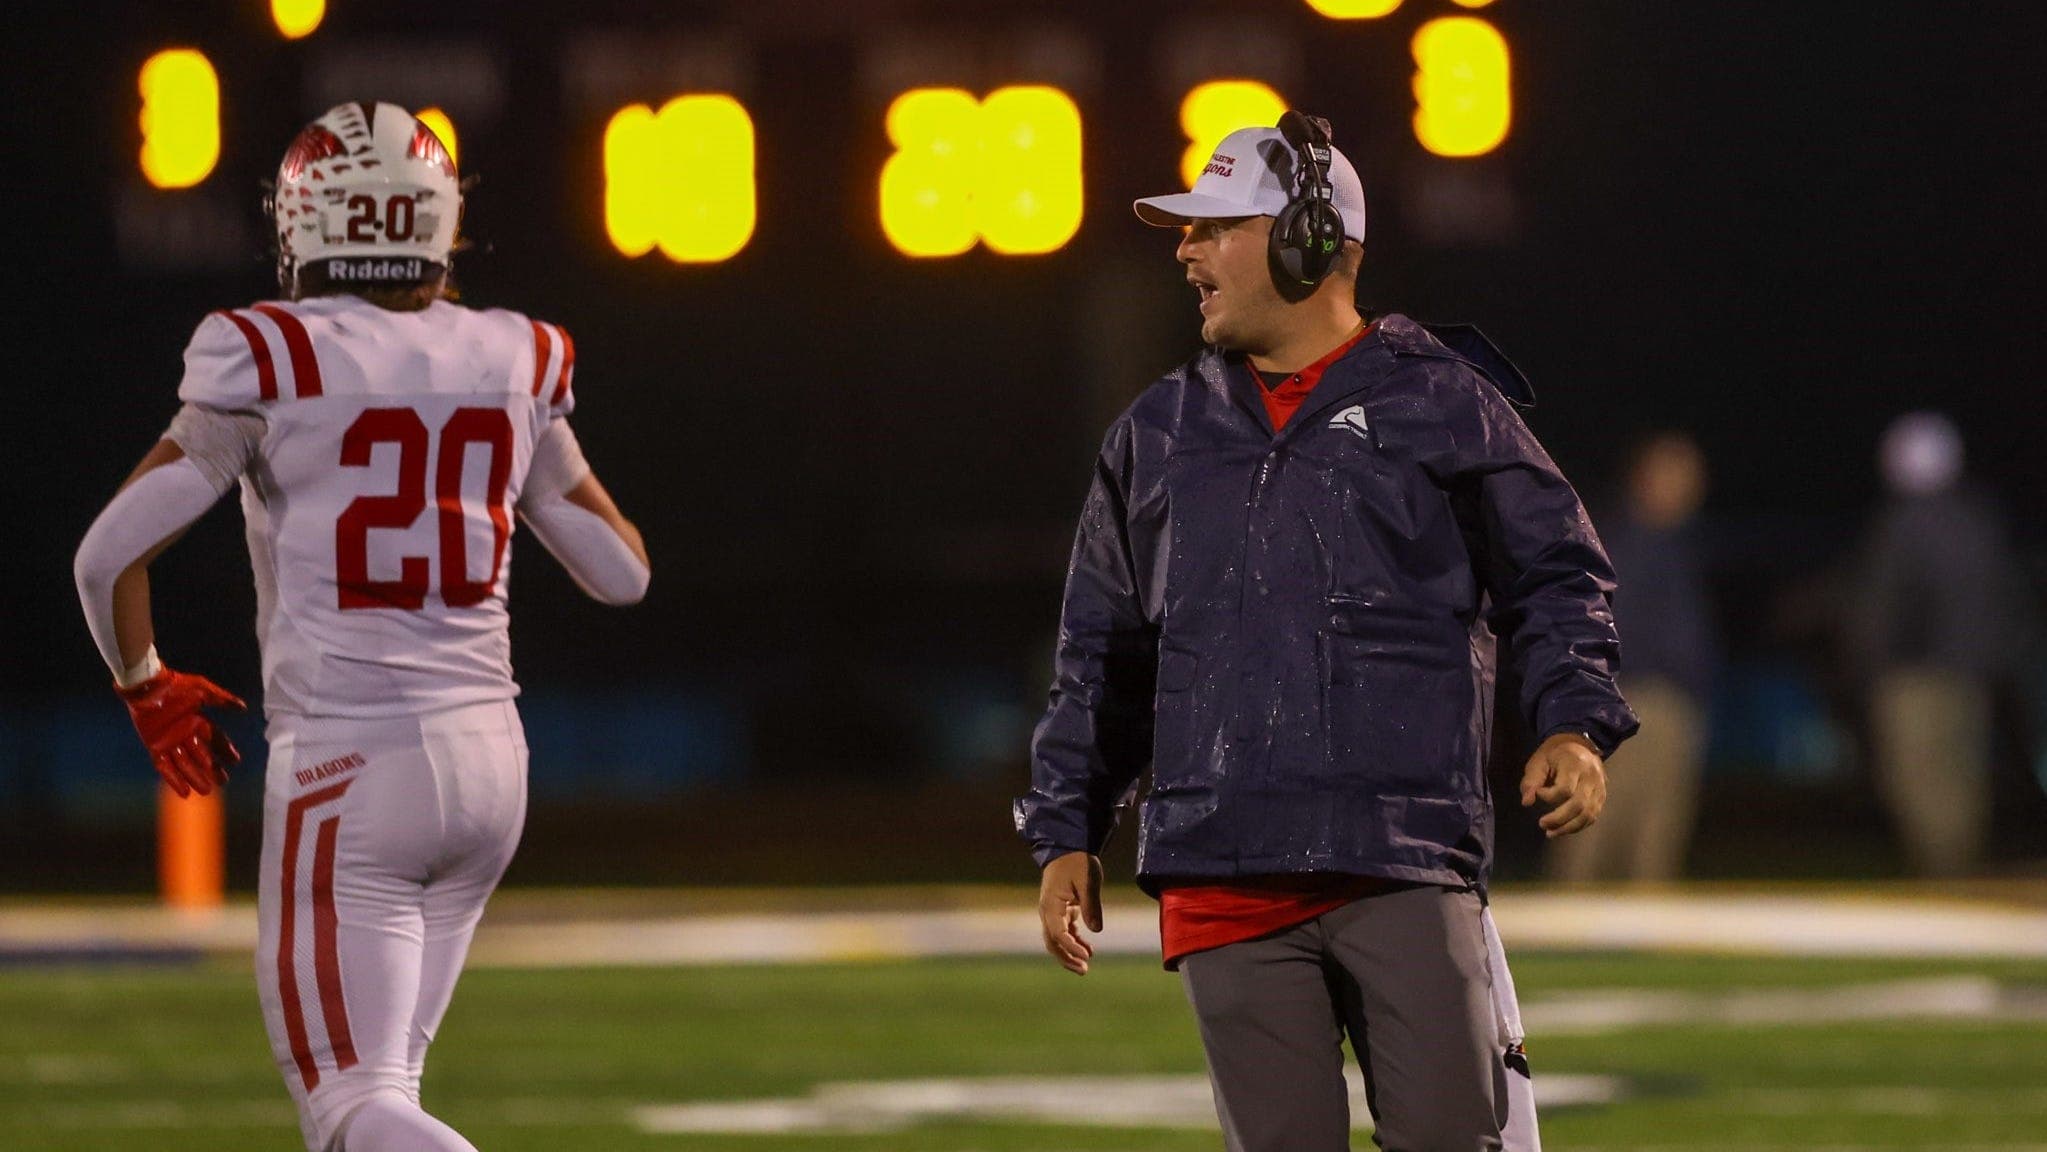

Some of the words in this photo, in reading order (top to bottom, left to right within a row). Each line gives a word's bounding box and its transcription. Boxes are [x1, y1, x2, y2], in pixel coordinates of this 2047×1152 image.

[1202, 162, 1233, 178] gons
[347, 194, 415, 243] 20
[329, 260, 421, 279] Riddell
[336, 406, 514, 611] 20
[295, 752, 366, 787] DRAGONS
